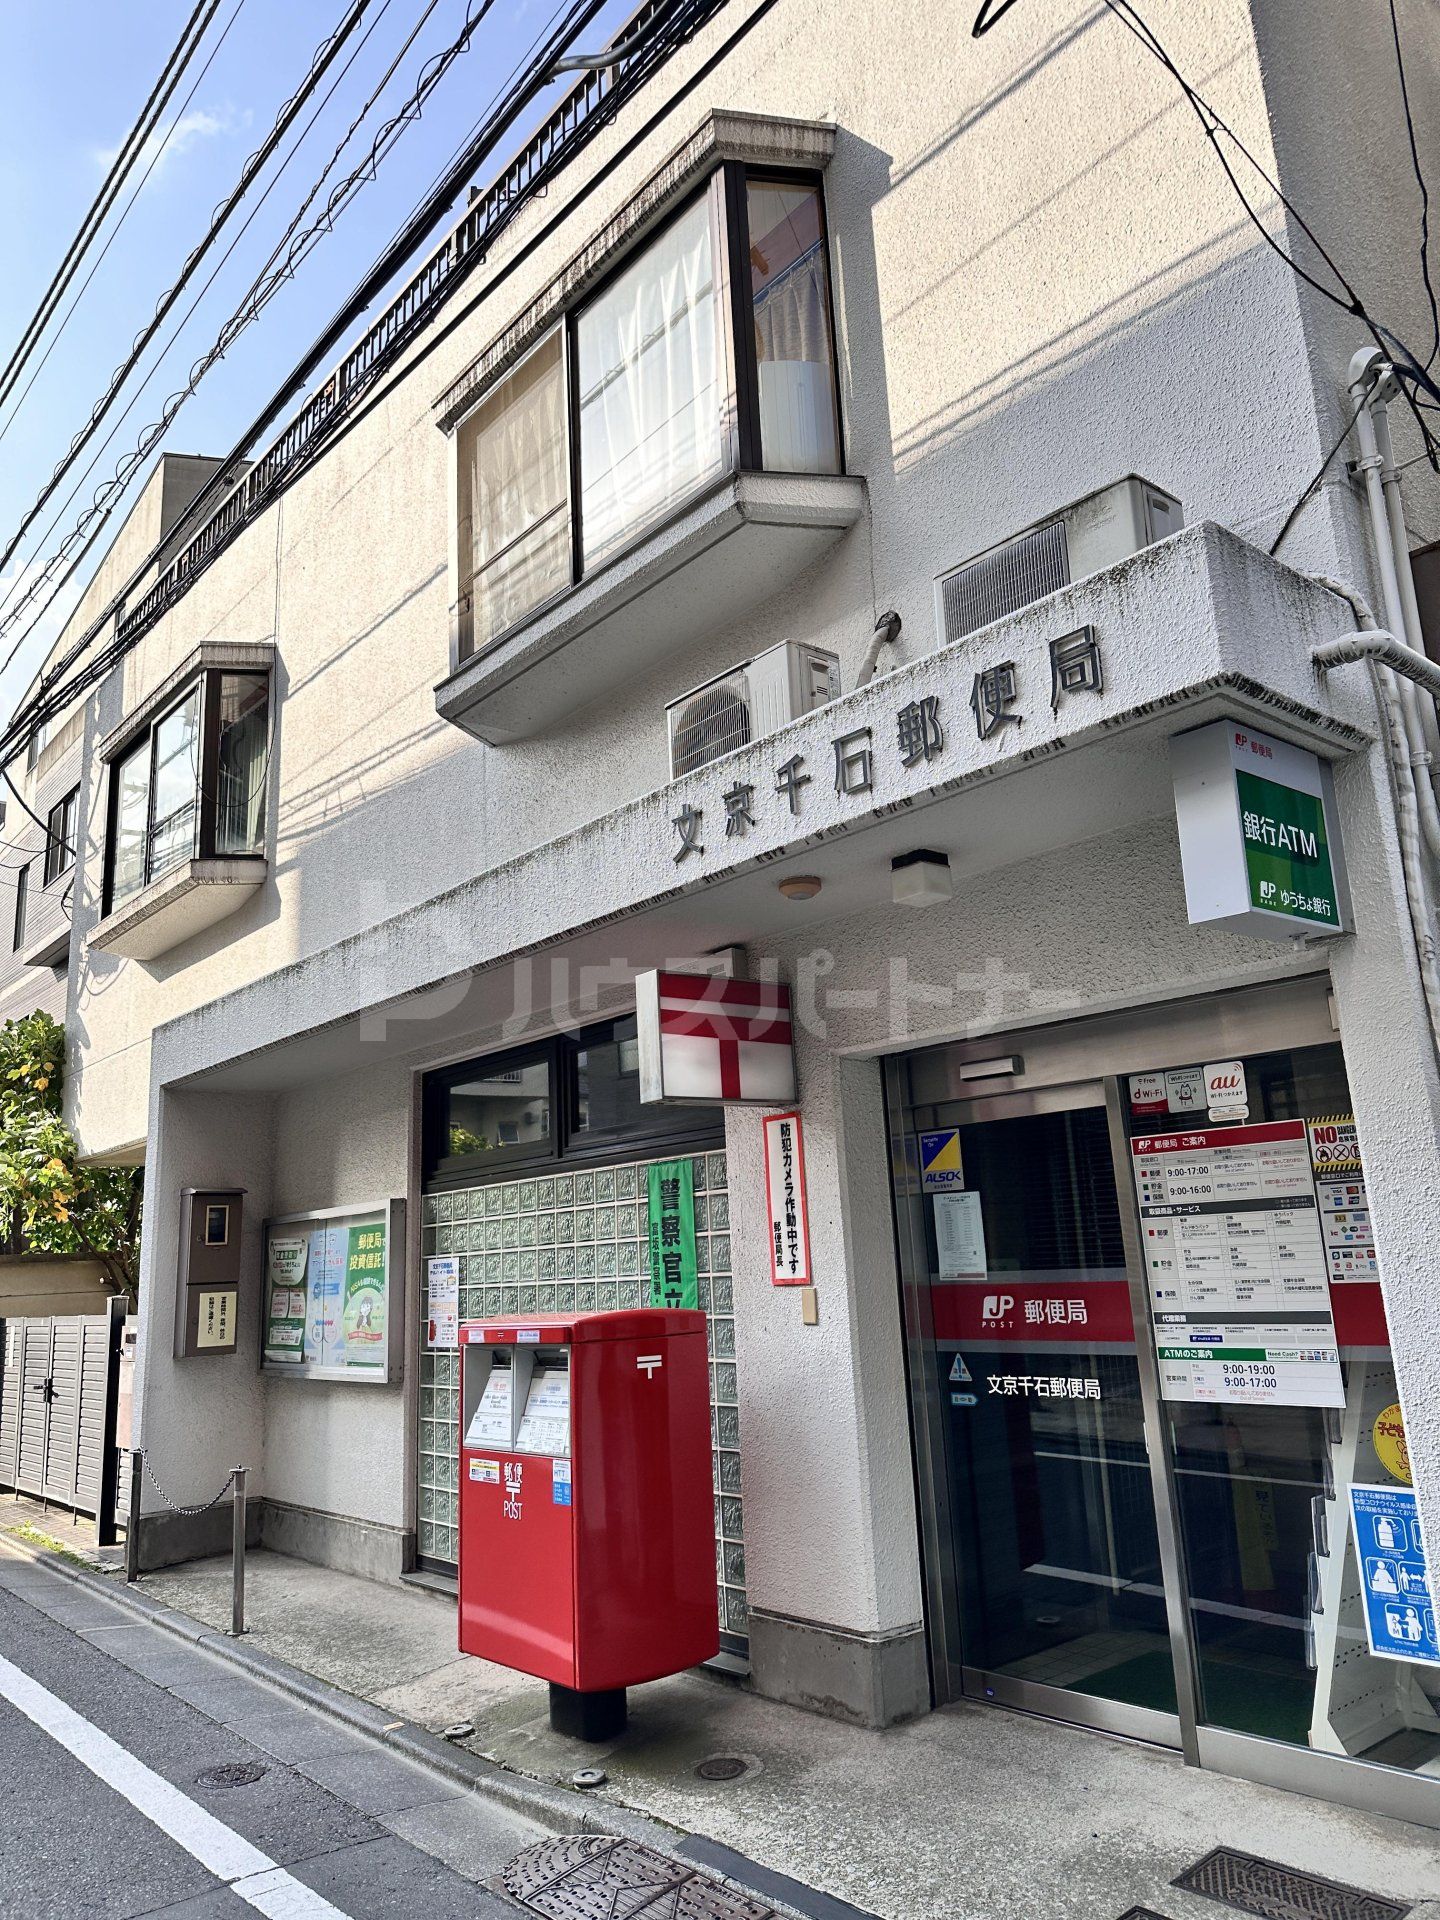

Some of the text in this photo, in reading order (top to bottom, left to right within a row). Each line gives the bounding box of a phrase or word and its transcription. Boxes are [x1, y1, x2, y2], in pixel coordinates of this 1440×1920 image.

[672, 624, 1103, 863] 文京千石郵便局
[1251, 741, 1272, 759] 郵便局
[1243, 810, 1318, 858] 銀行ATM
[1280, 889, 1331, 916] ゆうちょ銀行
[1211, 1075, 1241, 1090] au
[1154, 1139, 1178, 1149] 郵便局
[1182, 1136, 1206, 1147] ご案内
[1313, 1126, 1338, 1144] NO
[925, 1171, 961, 1183] ALSOK
[1149, 1169, 1161, 1177] 郵便
[1167, 1166, 1209, 1177] 9:00-17:00
[780, 1123, 799, 1275] 防犯カメラ作動中です
[1170, 1185, 1212, 1195] 9:00-16:00
[774, 1221, 784, 1267] 郵便局長
[1024, 1299, 1088, 1325] 郵便局
[1164, 1349, 1213, 1359] ATMのご案内
[1223, 1364, 1275, 1375] 9:00-19:00
[986, 1374, 1101, 1400] 文京千石郵便局
[1225, 1377, 1277, 1388] 9:00-17:00
[503, 1462, 523, 1484] 郵便
[503, 1501, 523, 1520] POST
